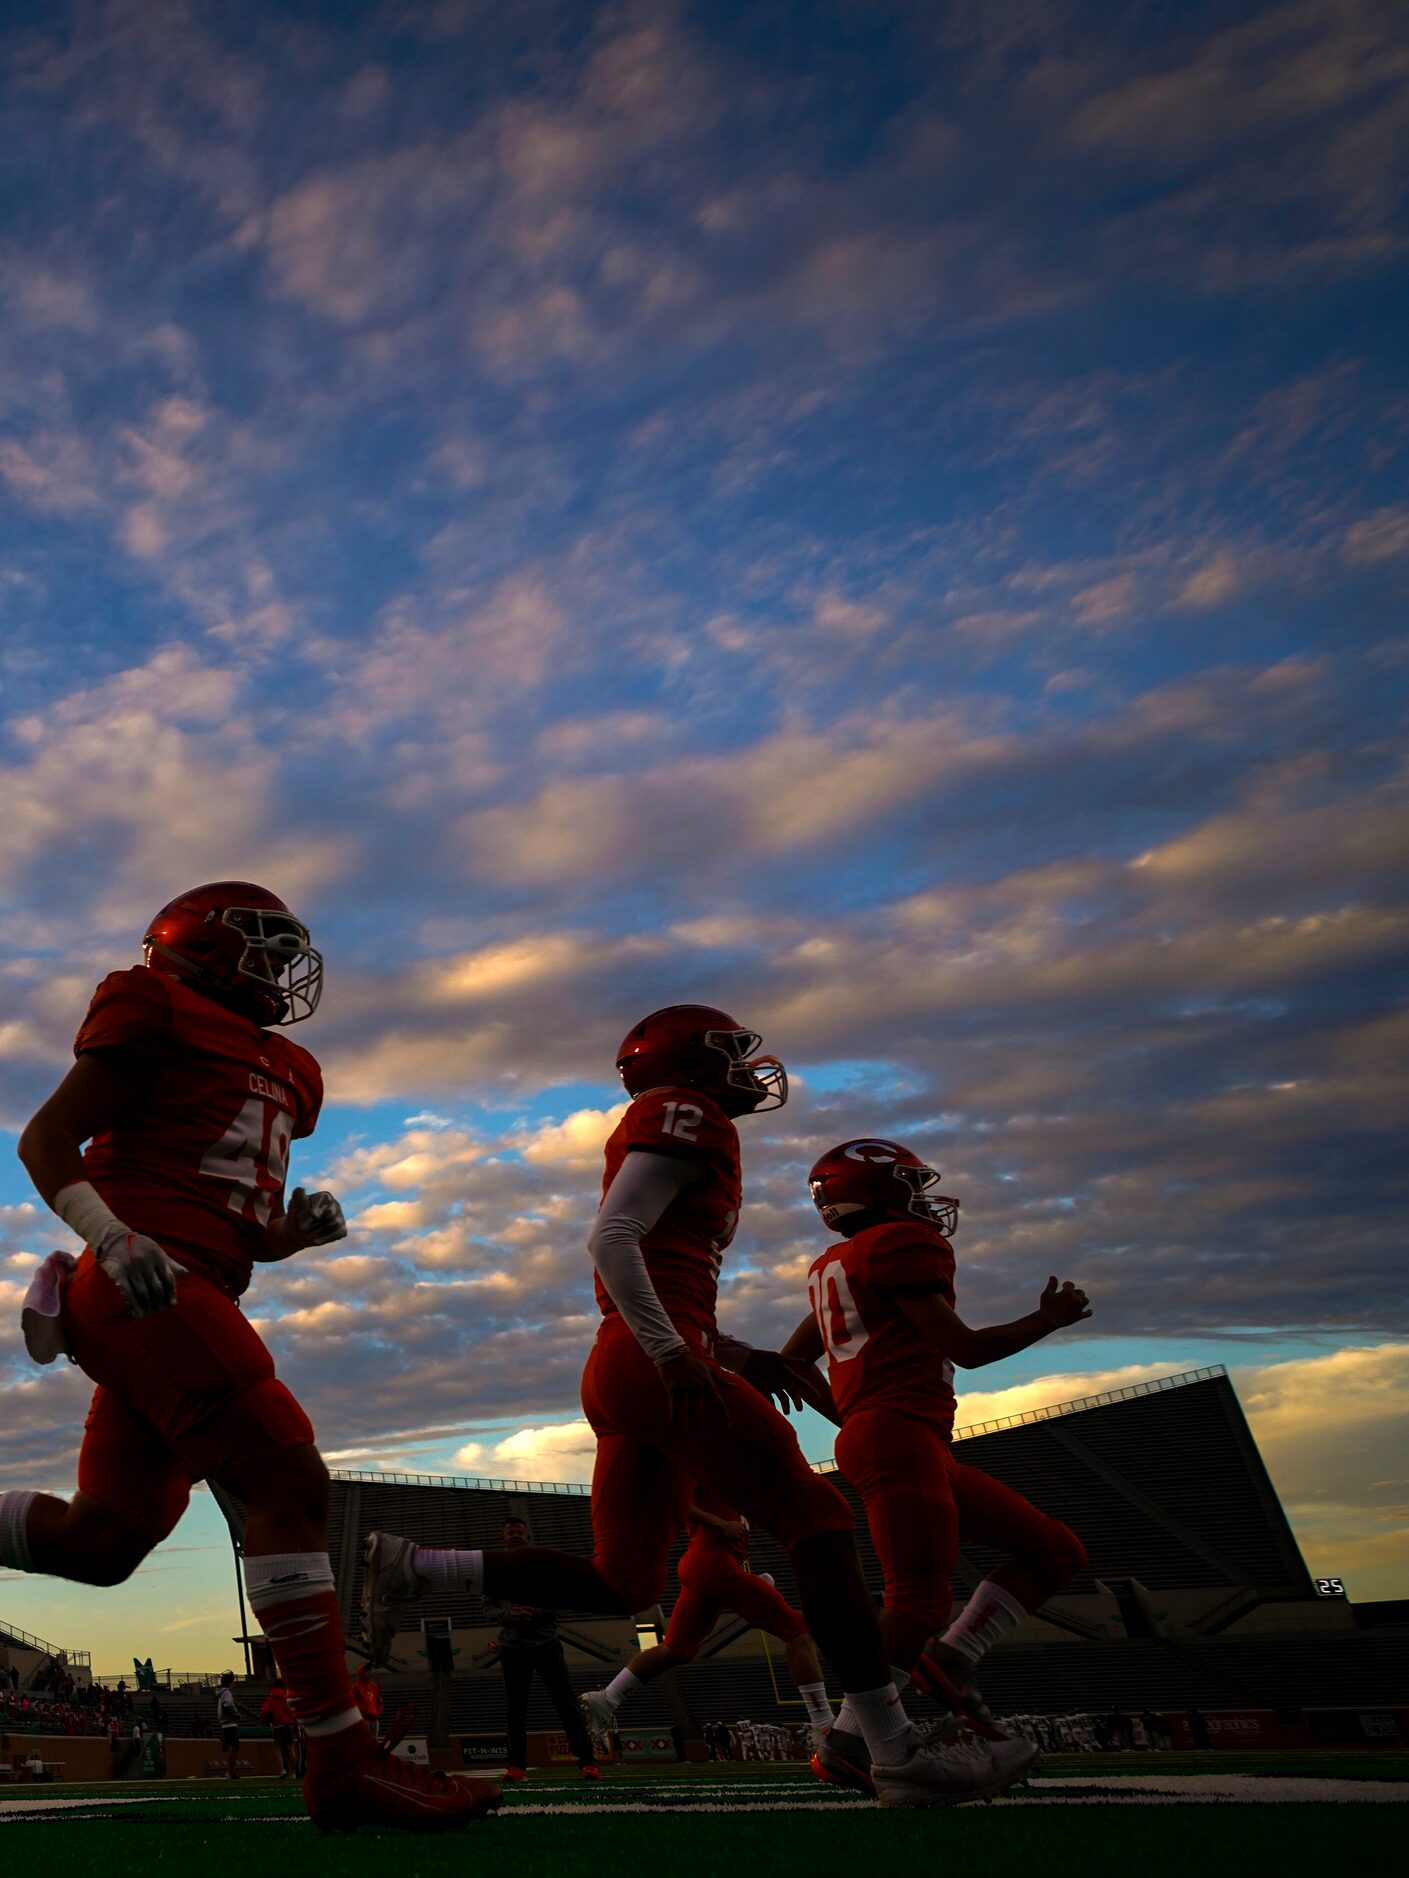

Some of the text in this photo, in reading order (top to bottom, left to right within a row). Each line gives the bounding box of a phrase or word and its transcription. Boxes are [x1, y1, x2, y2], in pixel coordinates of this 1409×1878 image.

[248, 1072, 289, 1107] CELINA
[661, 1101, 704, 1142] 12
[1318, 1580, 1344, 1594] 25
[463, 1747, 508, 1755] FIT-N-WIS
